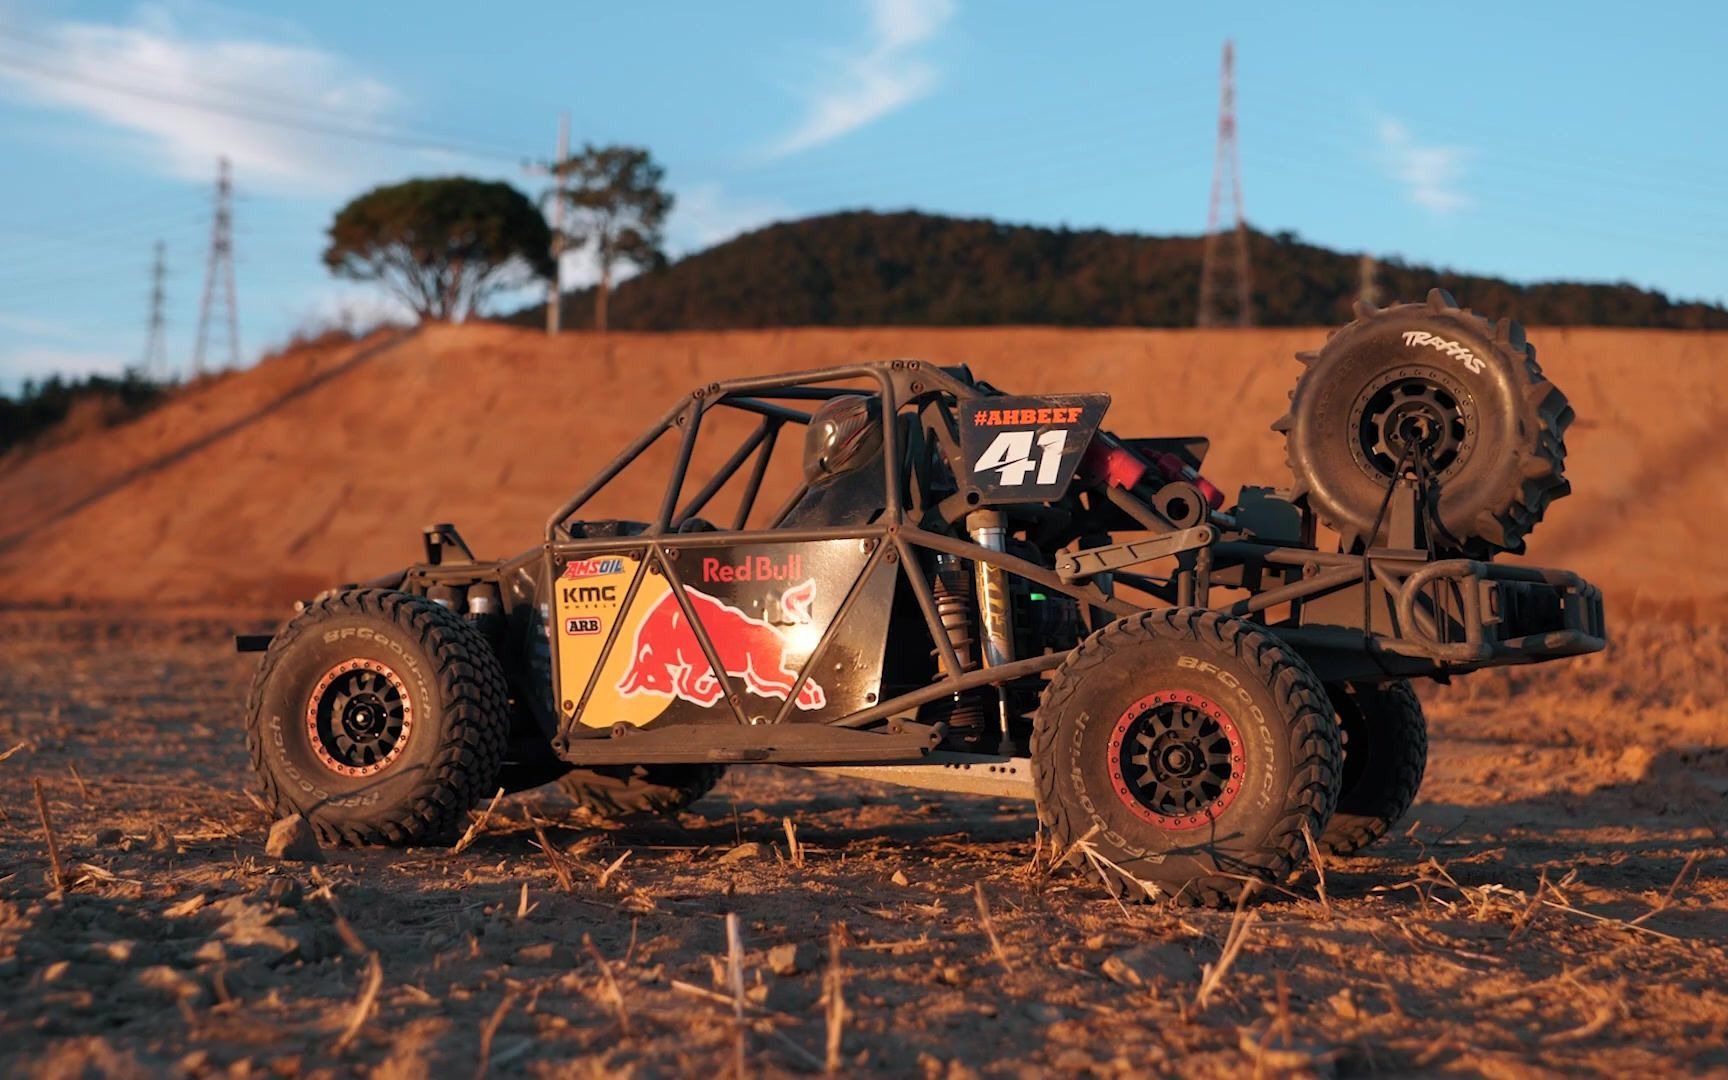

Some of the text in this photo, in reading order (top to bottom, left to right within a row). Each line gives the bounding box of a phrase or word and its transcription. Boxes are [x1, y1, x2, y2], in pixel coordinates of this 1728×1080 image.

[1402, 331, 1486, 374] TRAXXAS
[974, 407, 1083, 426] #AHBEEF
[974, 429, 1068, 486] 41
[563, 559, 625, 580] AMSOIL
[703, 555, 801, 582] Red Bull
[563, 586, 616, 603] KMC
[568, 619, 600, 633] ARB
[1177, 655, 1275, 809] BFGoodrich
